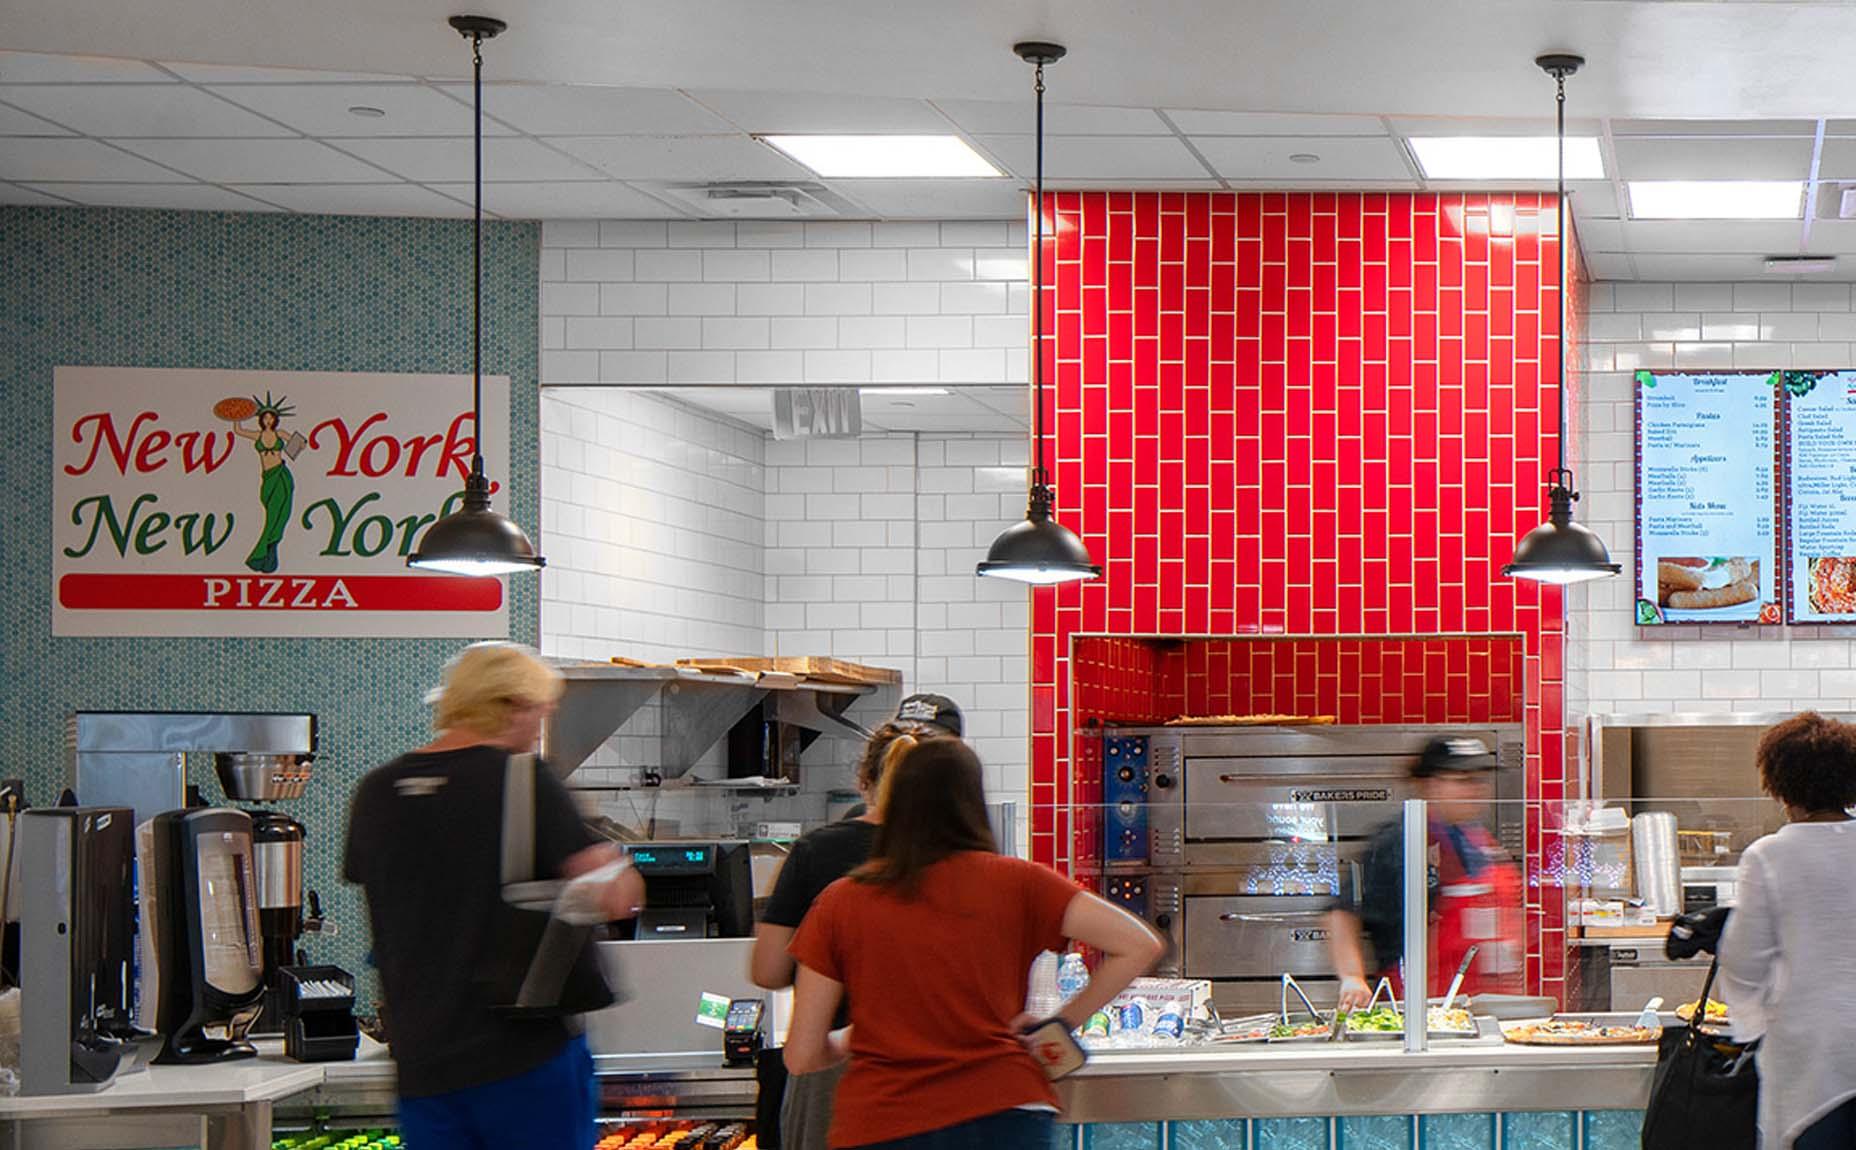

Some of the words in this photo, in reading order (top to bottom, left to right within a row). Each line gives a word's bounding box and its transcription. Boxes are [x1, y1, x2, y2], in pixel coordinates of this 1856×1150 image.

[63, 411, 235, 476] New
[63, 493, 235, 558] New
[302, 491, 466, 558] Yor
[203, 578, 358, 608] PIZZA
[1313, 790, 1354, 800] BAKERS
[1356, 790, 1386, 800] PRIDE
